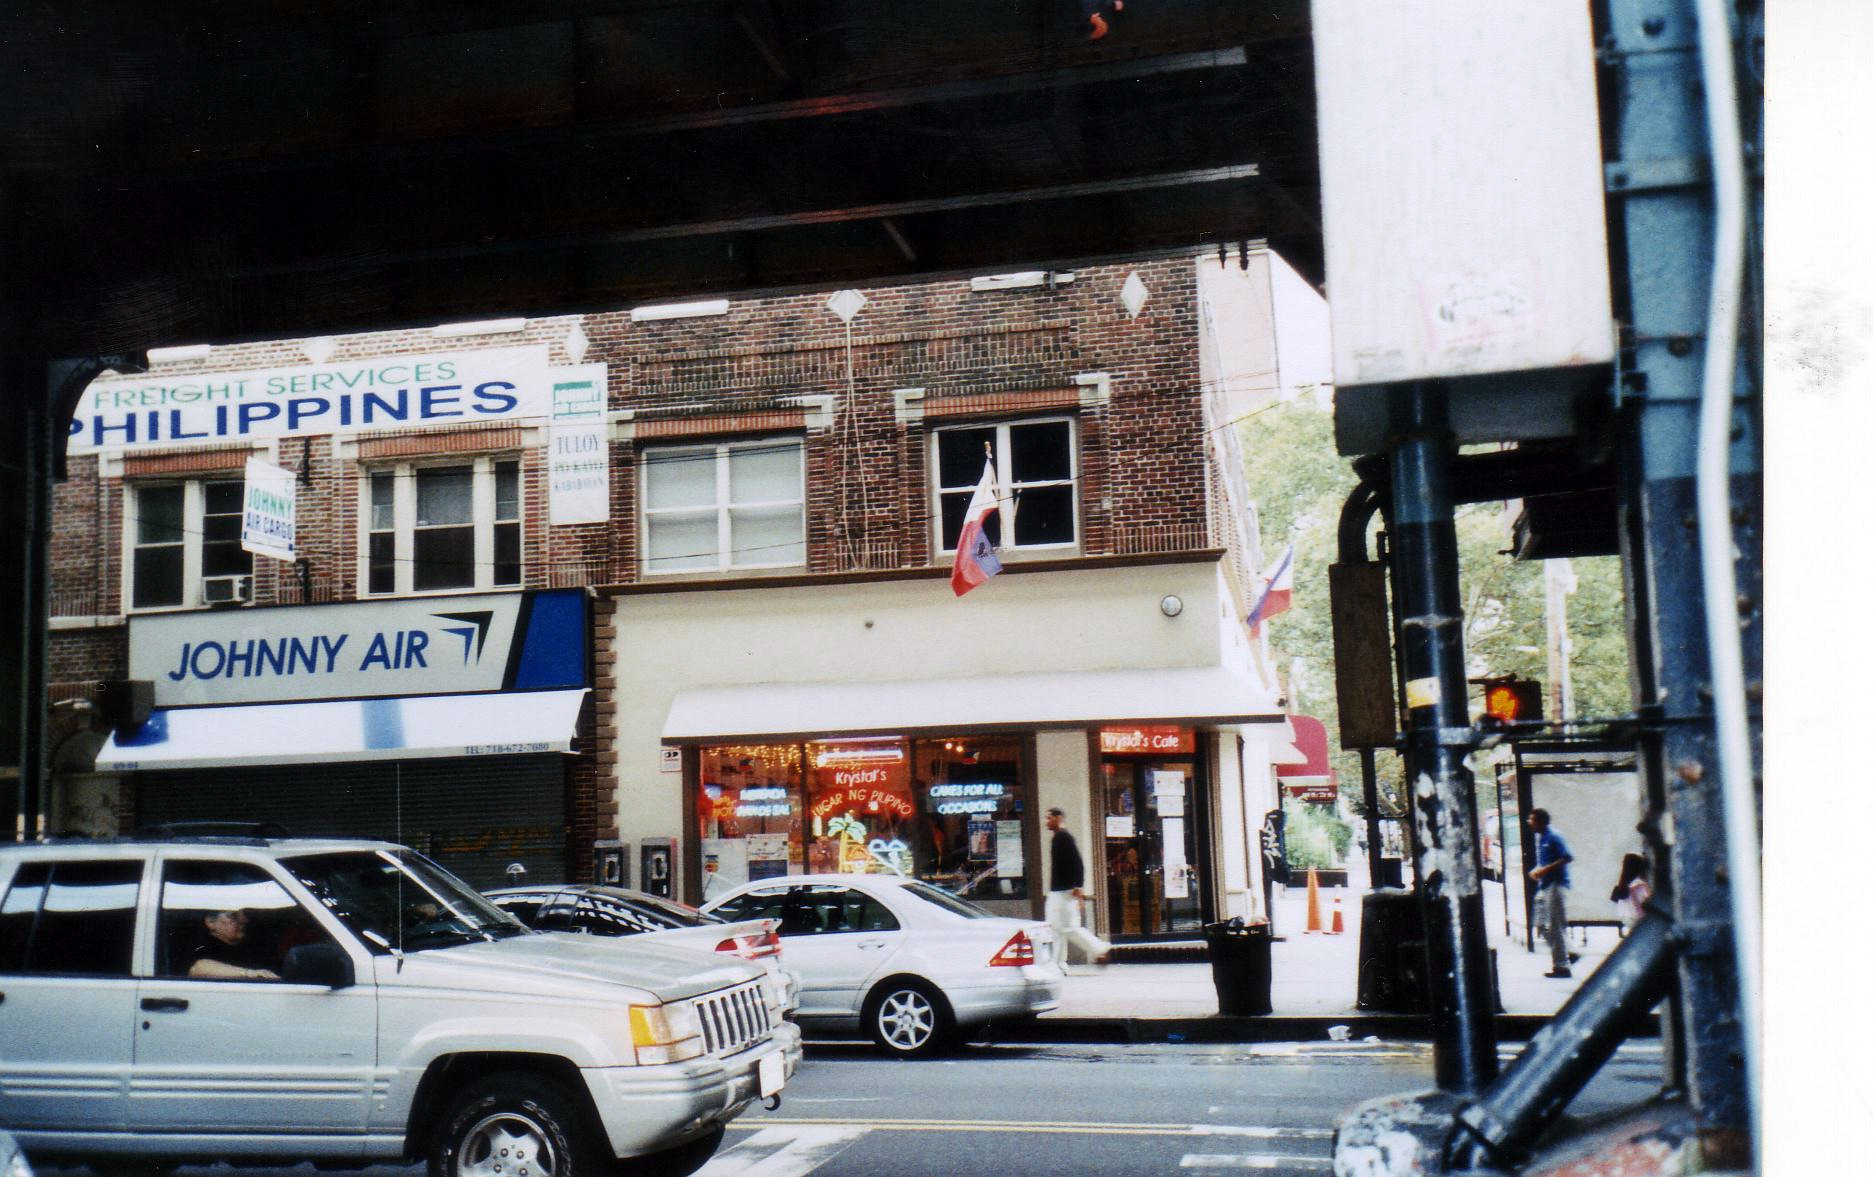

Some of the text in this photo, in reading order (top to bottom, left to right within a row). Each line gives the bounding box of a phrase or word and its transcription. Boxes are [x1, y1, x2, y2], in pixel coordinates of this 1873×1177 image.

[95, 362, 456, 409] FREIGHT SERVICES
[556, 434, 600, 454] TULOY
[248, 487, 293, 519] JOHNNY
[247, 512, 293, 541] AIR CARGO
[168, 630, 429, 681] JOHNNY AIR
[1152, 735, 1179, 749] Cafe
[835, 769, 887, 787] Krystal's
[964, 785, 985, 796] FOR
[986, 784, 1004, 795] ALL
[848, 789, 867, 801] NG
[870, 790, 912, 815] PILIPINO
